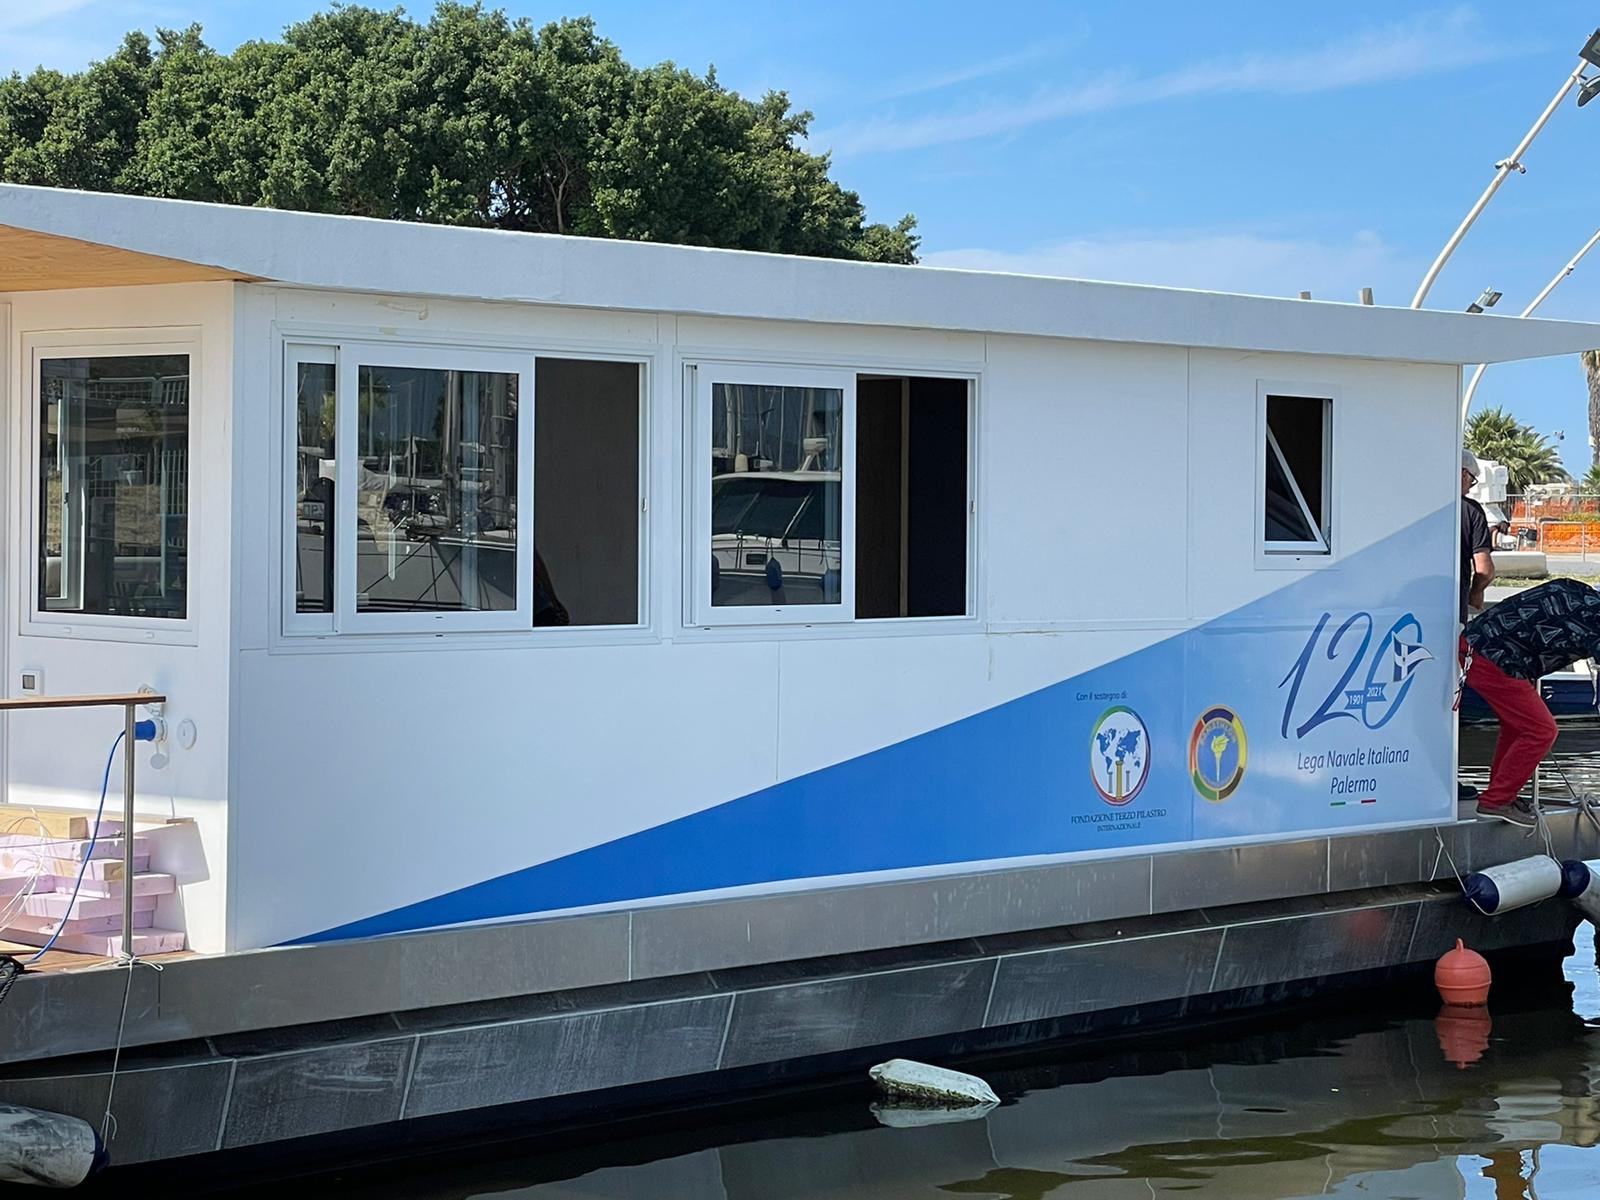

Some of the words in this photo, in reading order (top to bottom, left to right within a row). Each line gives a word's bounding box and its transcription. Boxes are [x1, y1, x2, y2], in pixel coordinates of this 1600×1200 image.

[1277, 611, 1424, 740] 120
[1076, 691, 1089, 702] Con
[1094, 691, 1120, 703] sostegno
[1349, 693, 1364, 705] 1901
[1367, 686, 1382, 697] 2021
[1297, 752, 1324, 775] Lega
[1327, 748, 1365, 769] Navale
[1367, 746, 1409, 766] Italiana
[1330, 776, 1377, 795] Palermo
[1071, 812, 1114, 825] FONDAZIONE
[1115, 810, 1136, 821] TERZO
[1136, 808, 1167, 819] PILASTRO
[1096, 821, 1141, 833] INTERNAZIONALE
